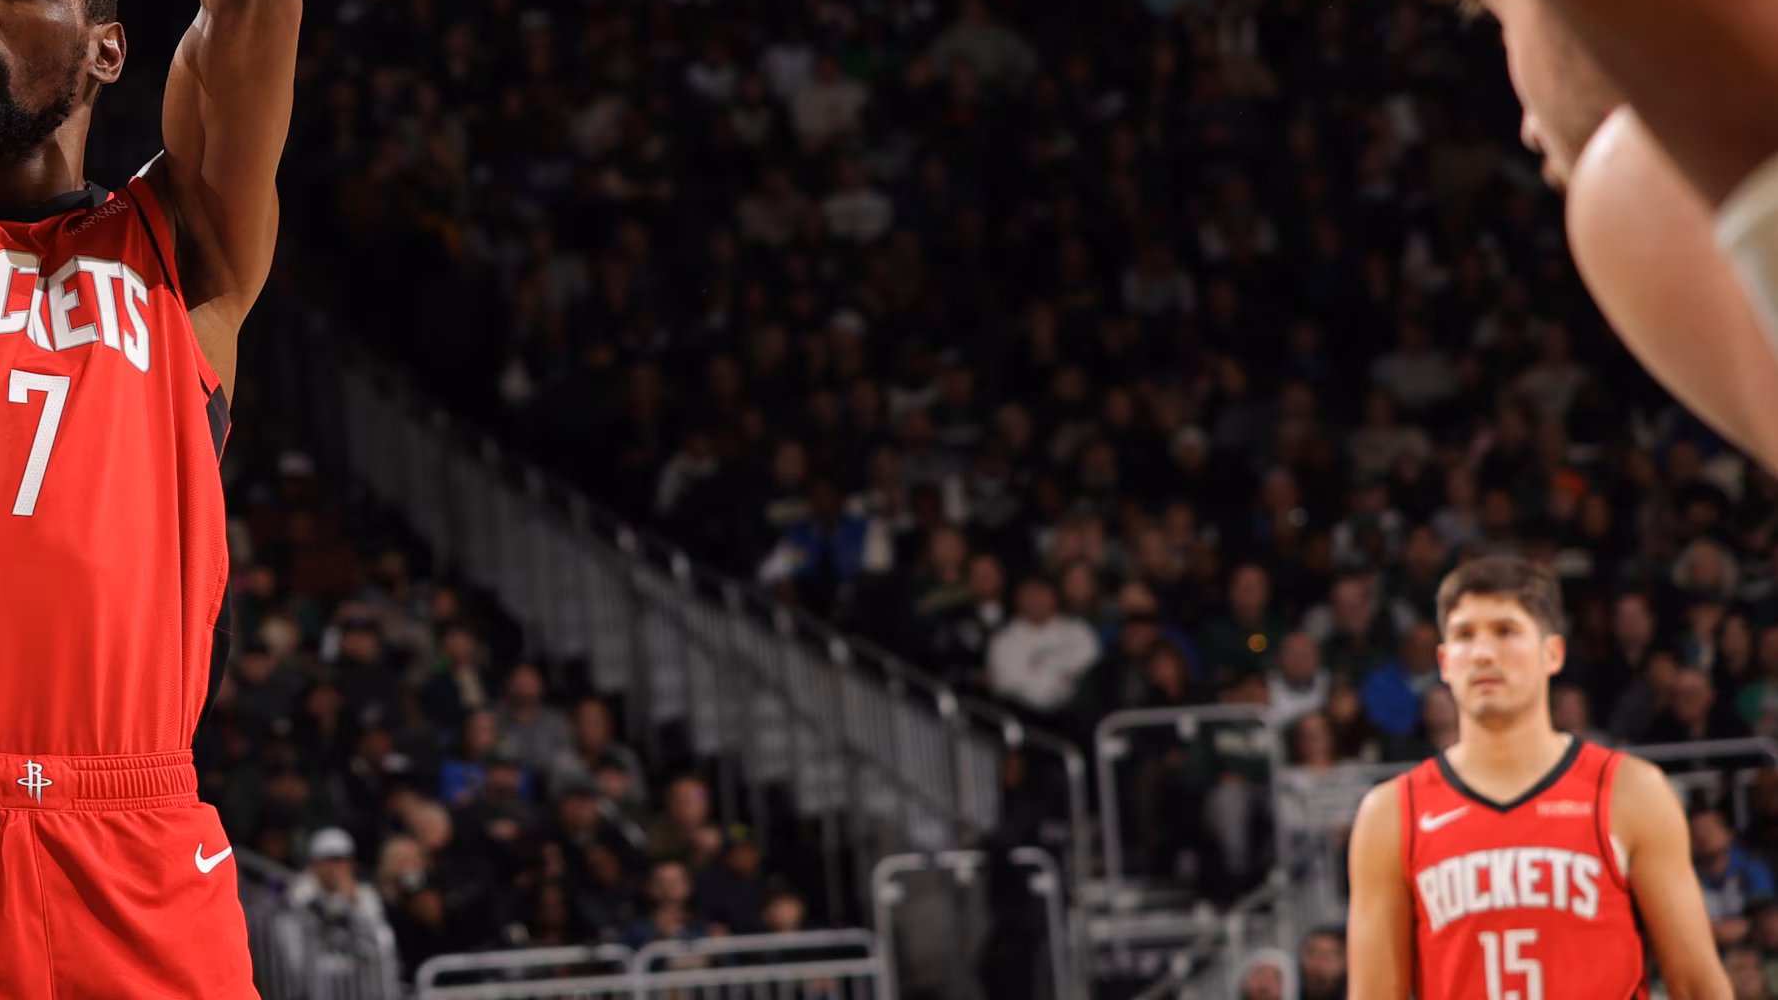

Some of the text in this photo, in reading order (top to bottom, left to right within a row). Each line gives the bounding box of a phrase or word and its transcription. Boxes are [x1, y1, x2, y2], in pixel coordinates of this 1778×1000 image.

[8, 369, 70, 516] 7
[1416, 846, 1601, 933] ROCKETS
[1478, 928, 1543, 1000] 15
